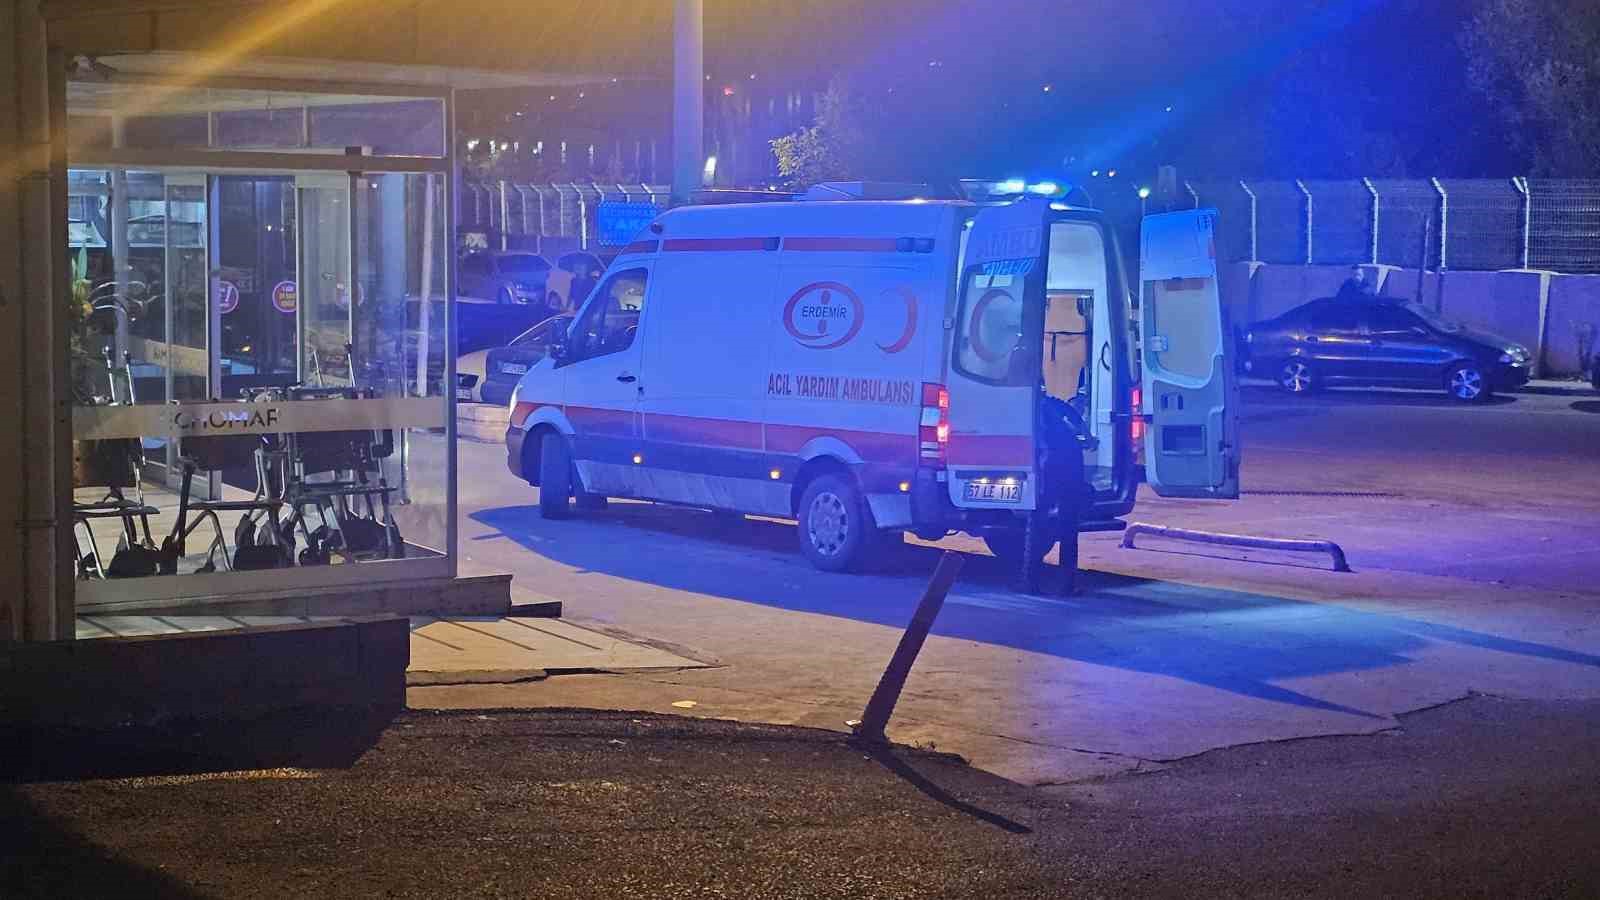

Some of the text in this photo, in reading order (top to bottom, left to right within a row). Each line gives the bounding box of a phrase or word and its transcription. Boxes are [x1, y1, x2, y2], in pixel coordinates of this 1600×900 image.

[801, 304, 848, 320] ERDEMİR
[796, 375, 839, 399] YARDIM
[841, 379, 914, 405] AMBULANSI
